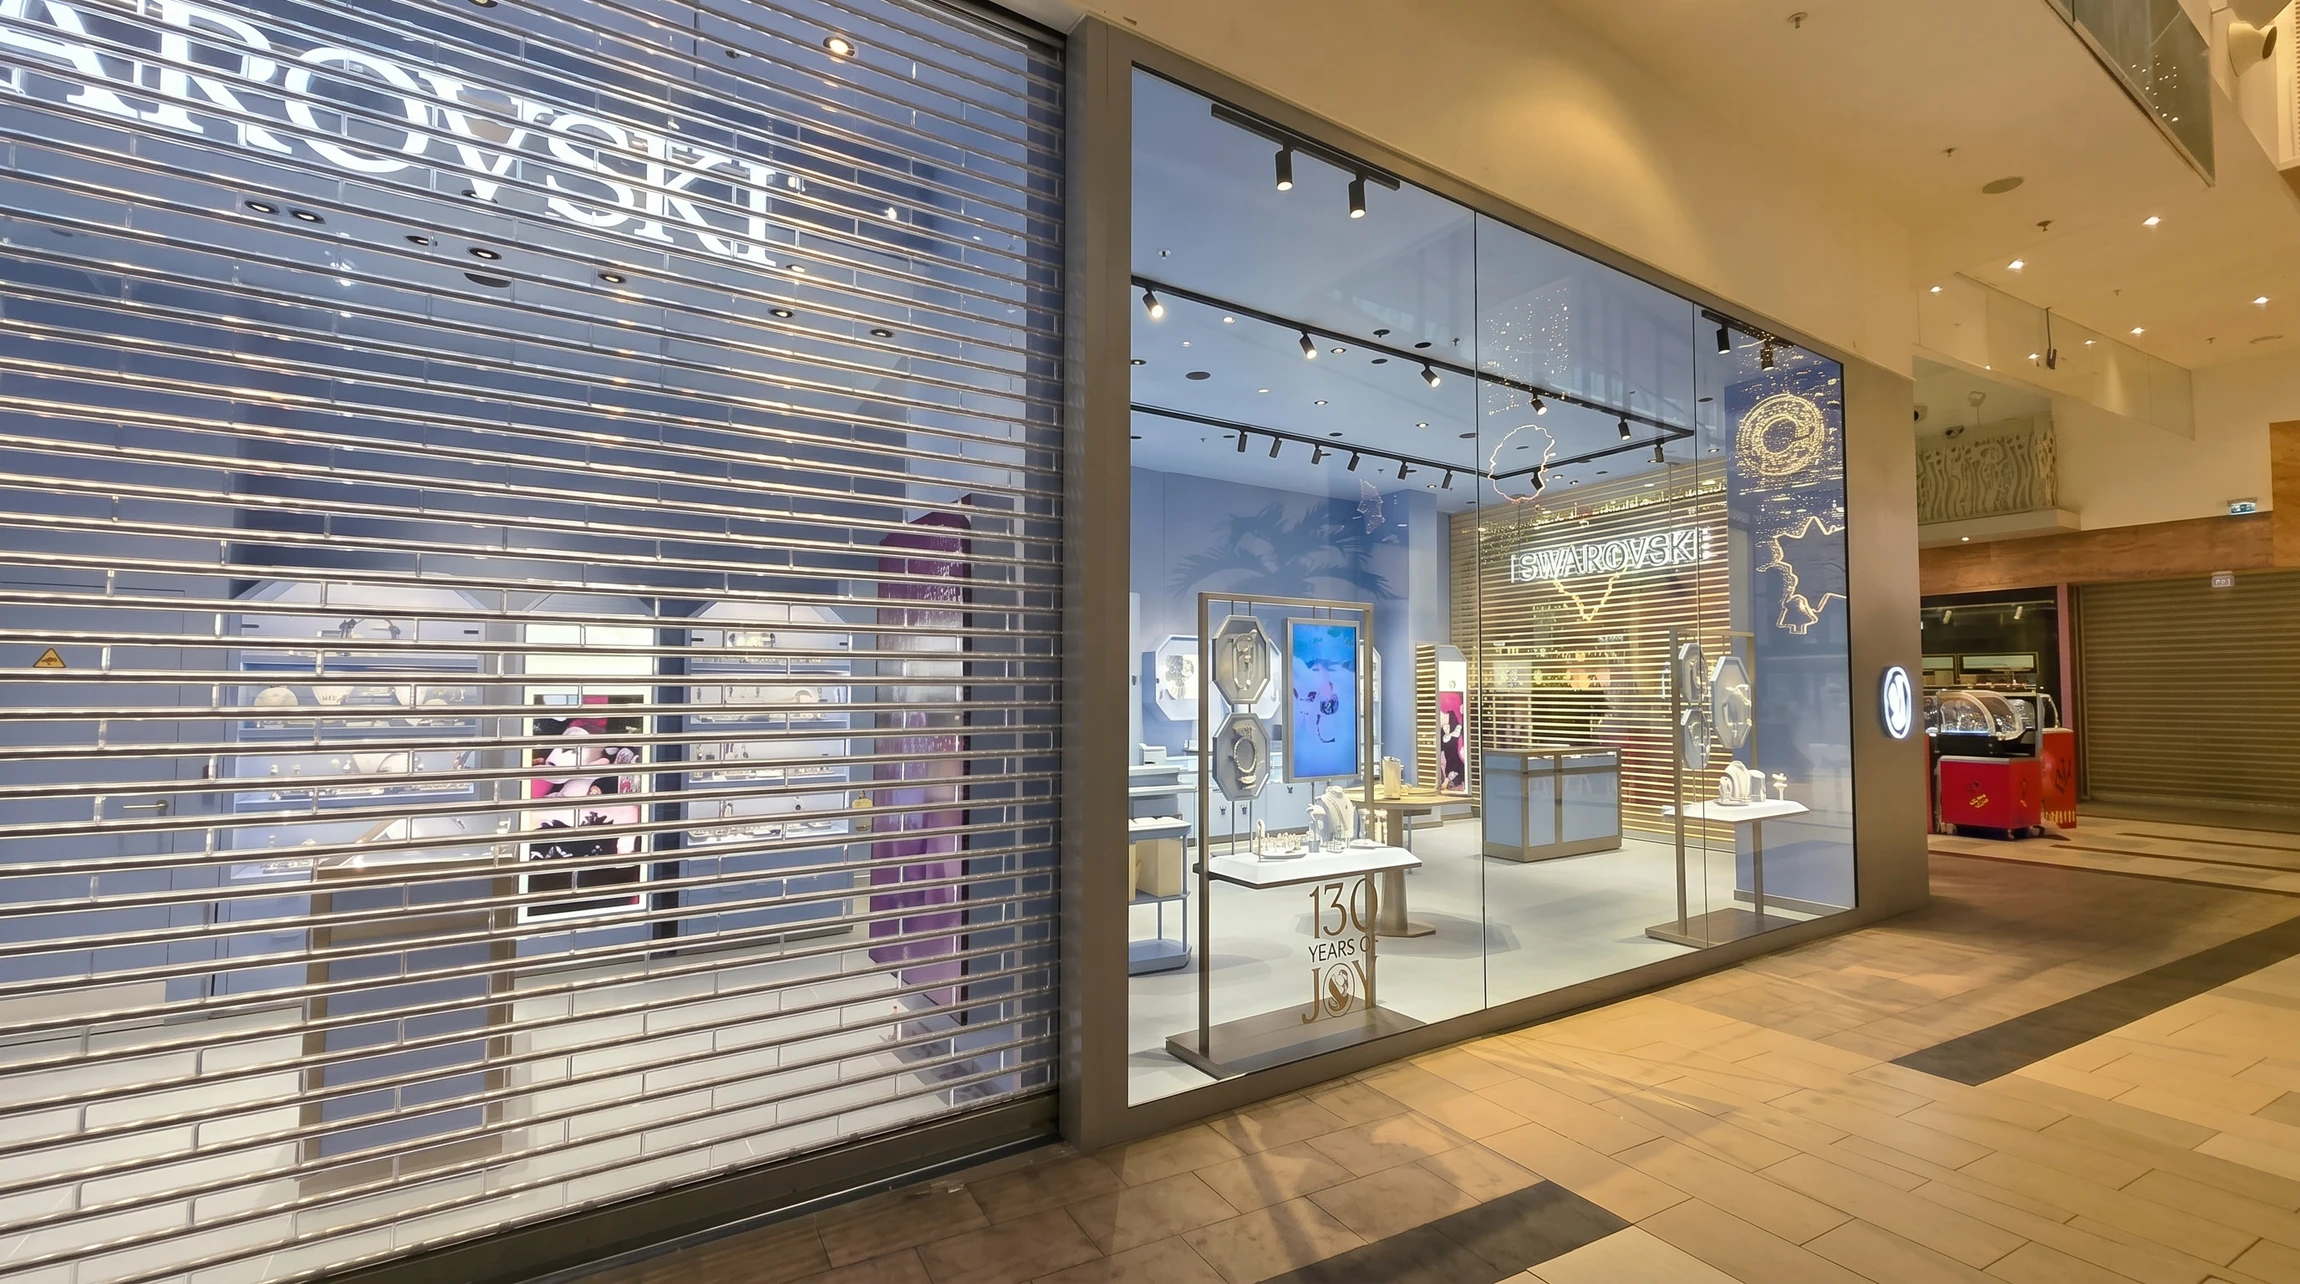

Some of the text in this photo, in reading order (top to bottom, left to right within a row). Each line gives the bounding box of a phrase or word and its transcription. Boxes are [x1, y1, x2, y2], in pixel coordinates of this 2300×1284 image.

[1309, 878, 1378, 939] 130
[1308, 938, 1355, 963] YEARS
[1302, 956, 1379, 1024] JOY
